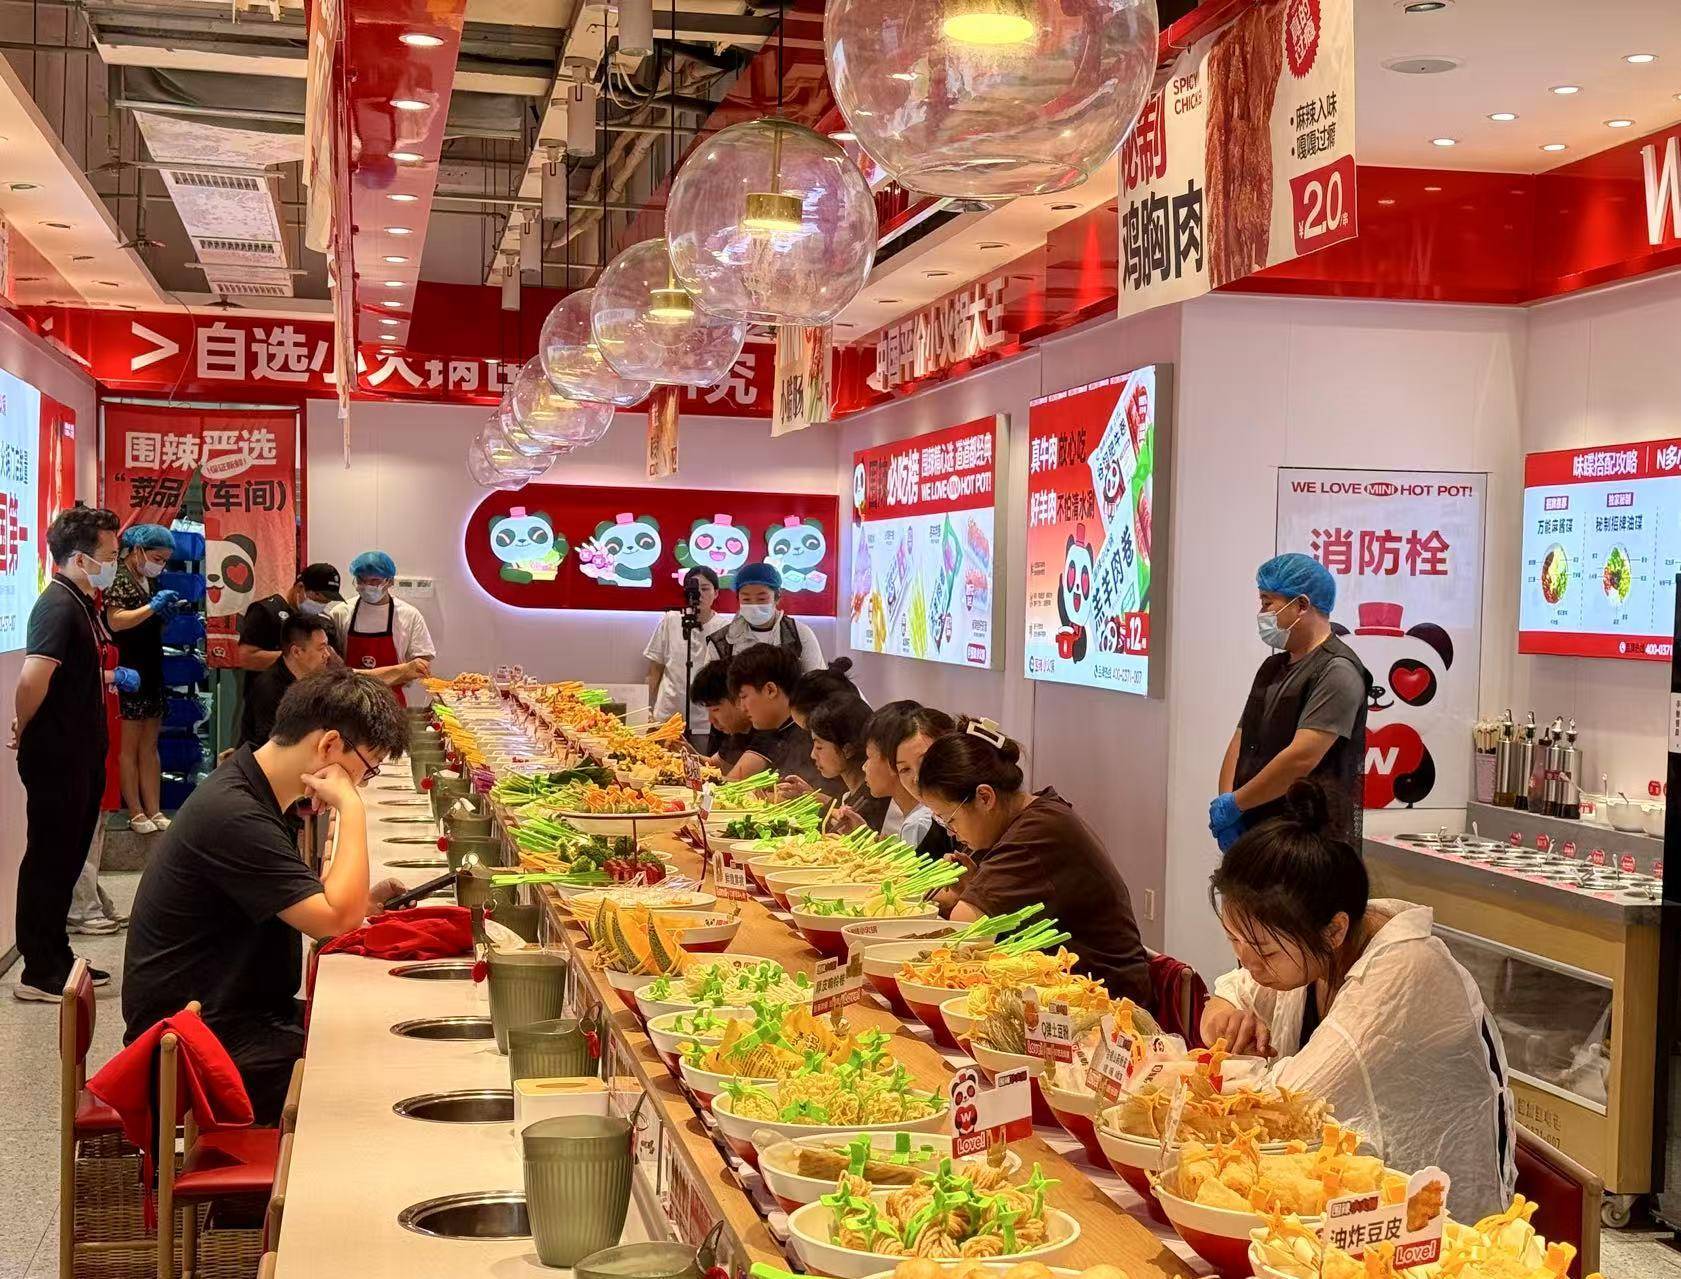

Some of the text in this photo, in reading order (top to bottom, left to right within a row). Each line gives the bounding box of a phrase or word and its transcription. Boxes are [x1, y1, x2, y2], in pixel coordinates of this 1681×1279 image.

[1173, 72, 1198, 96] SPICY
[1295, 91, 1338, 132] 麻辣入味
[1296, 122, 1337, 160] 嘎嘎过瘾
[1121, 179, 1204, 291] 鸡胸肉
[875, 277, 1008, 390] 中国平价小火锅大王
[125, 428, 277, 471] 围辣严选
[1572, 449, 1638, 478] 味碟搭配攻略
[887, 448, 919, 506] 必吃榜
[921, 483, 932, 502] WE
[932, 480, 947, 500] LOVE
[960, 475, 976, 496] HOT
[975, 472, 992, 494] POT!
[1291, 481, 1473, 498] WE LOVE MINI HOT POT!
[1310, 527, 1451, 577] 消防栓
[957, 1131, 986, 1154] Love!
[1330, 1217, 1403, 1250] 油炸豆皮
[1396, 1240, 1436, 1265] Love!
